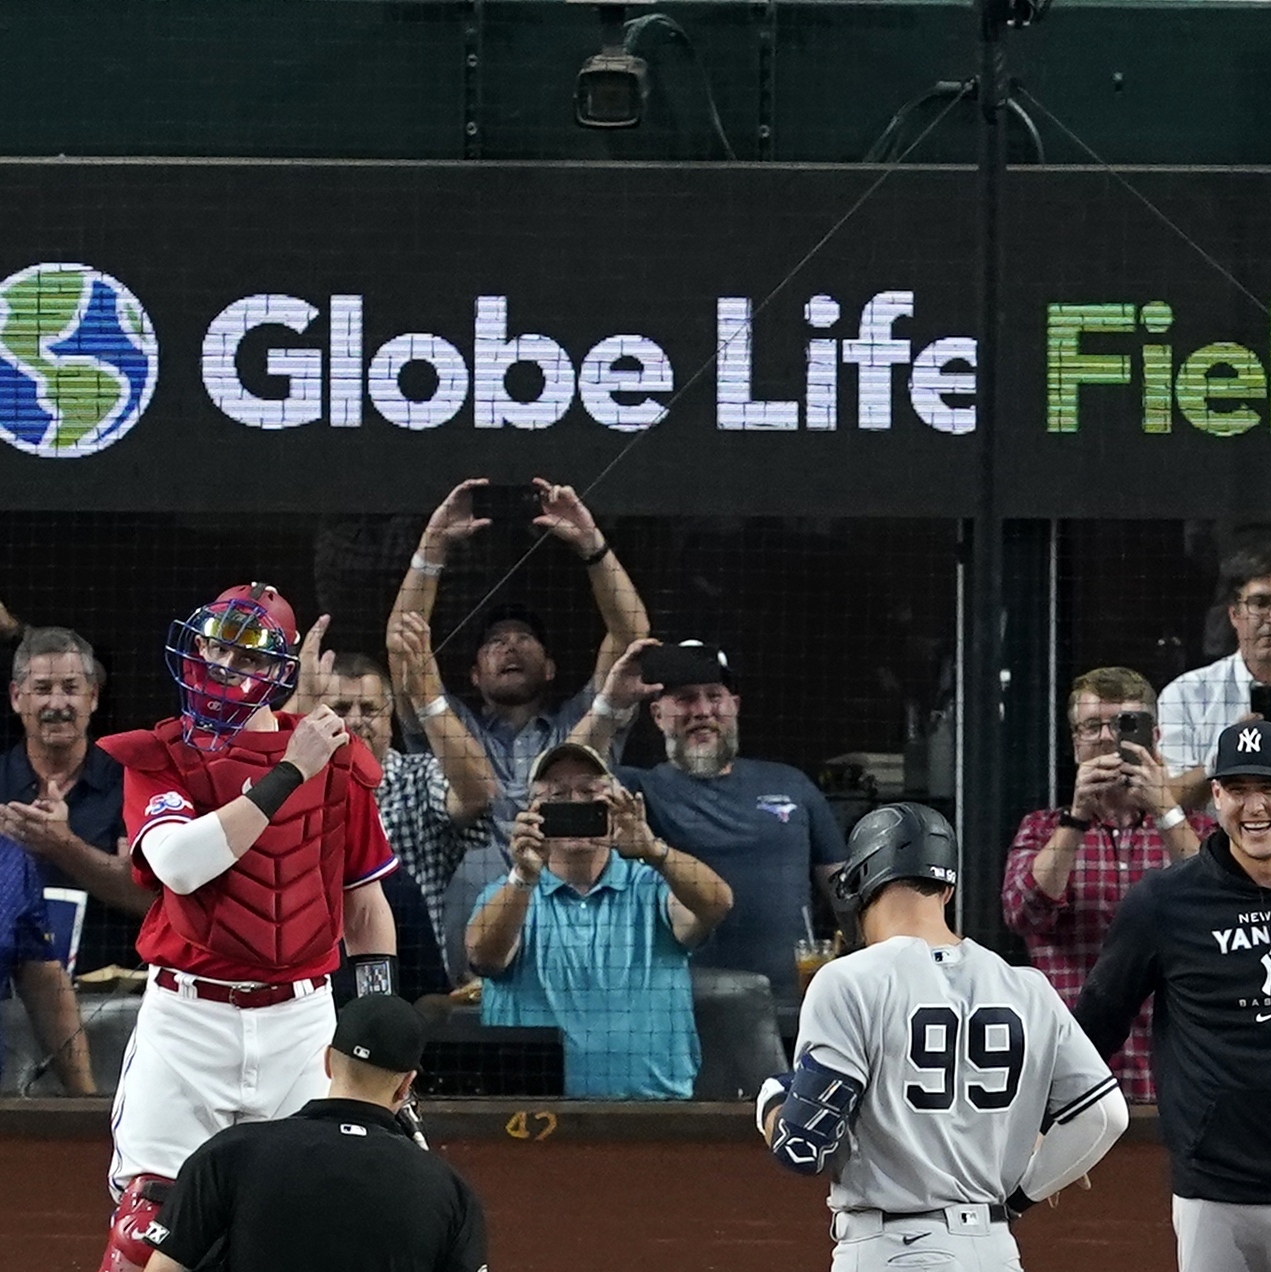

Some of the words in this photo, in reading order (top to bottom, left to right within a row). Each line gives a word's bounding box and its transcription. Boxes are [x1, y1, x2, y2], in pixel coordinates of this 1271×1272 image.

[201, 293, 674, 432] Globe
[716, 290, 979, 436] Life
[1238, 910, 1271, 924] NEW
[904, 1003, 1028, 1113] 99
